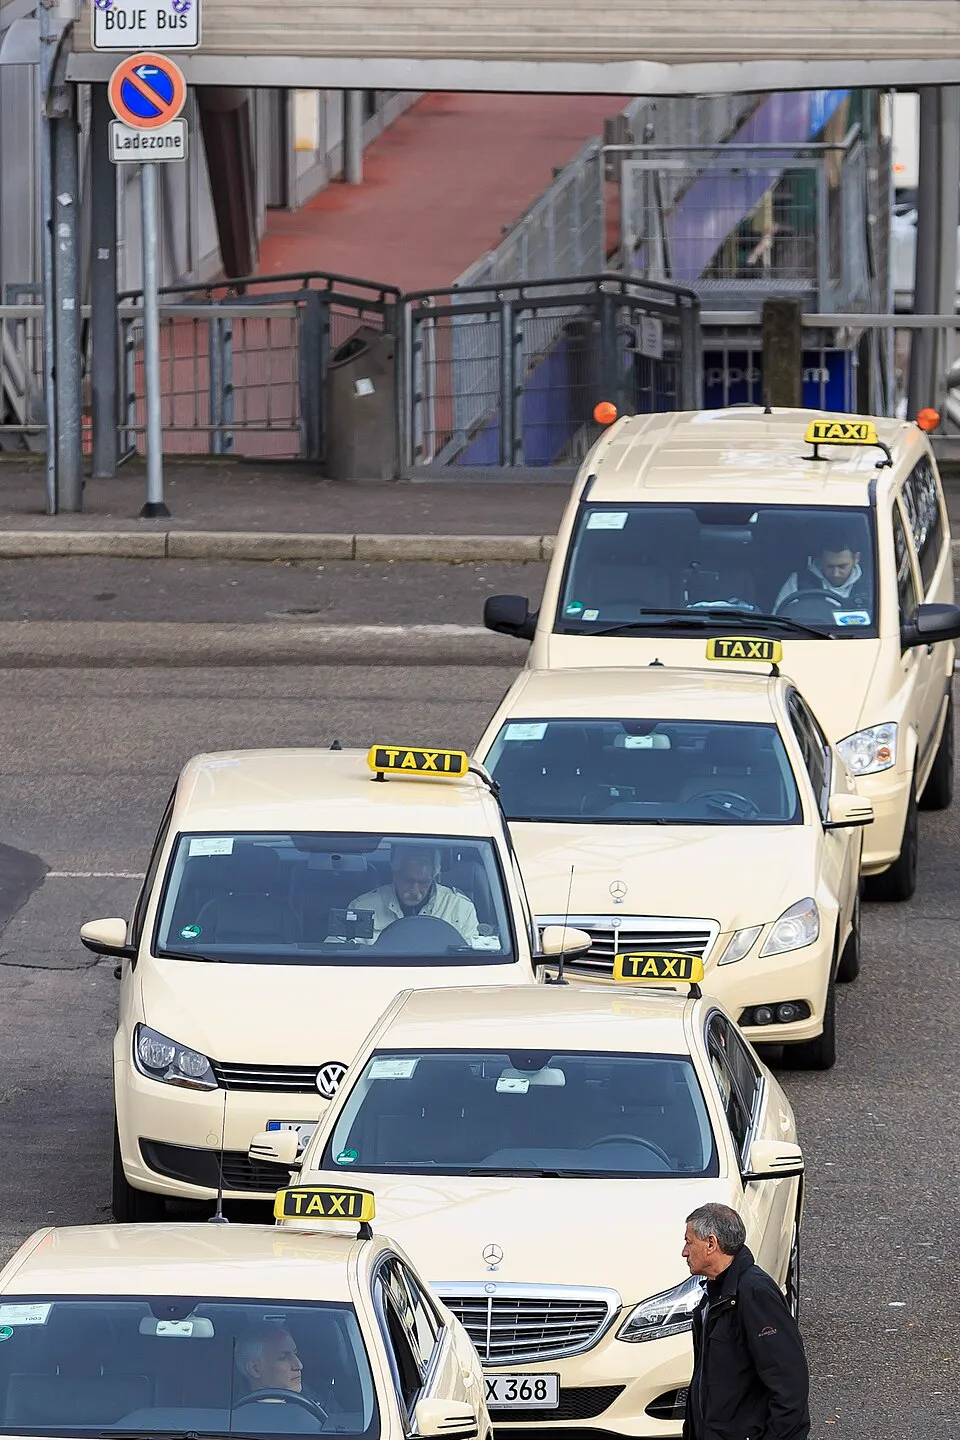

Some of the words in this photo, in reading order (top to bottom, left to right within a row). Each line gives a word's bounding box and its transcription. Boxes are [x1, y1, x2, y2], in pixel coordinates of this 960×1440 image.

[105, 10, 146, 29] BOJE
[157, 10, 187, 29] Bus
[115, 133, 181, 149] Ladezone
[816, 423, 868, 439] TAXI
[719, 641, 769, 659] TAXI
[386, 751, 451, 771] TAXI
[629, 957, 686, 978] TAXI
[292, 1194, 355, 1215] TAXI
[504, 1379, 547, 1401] 368
